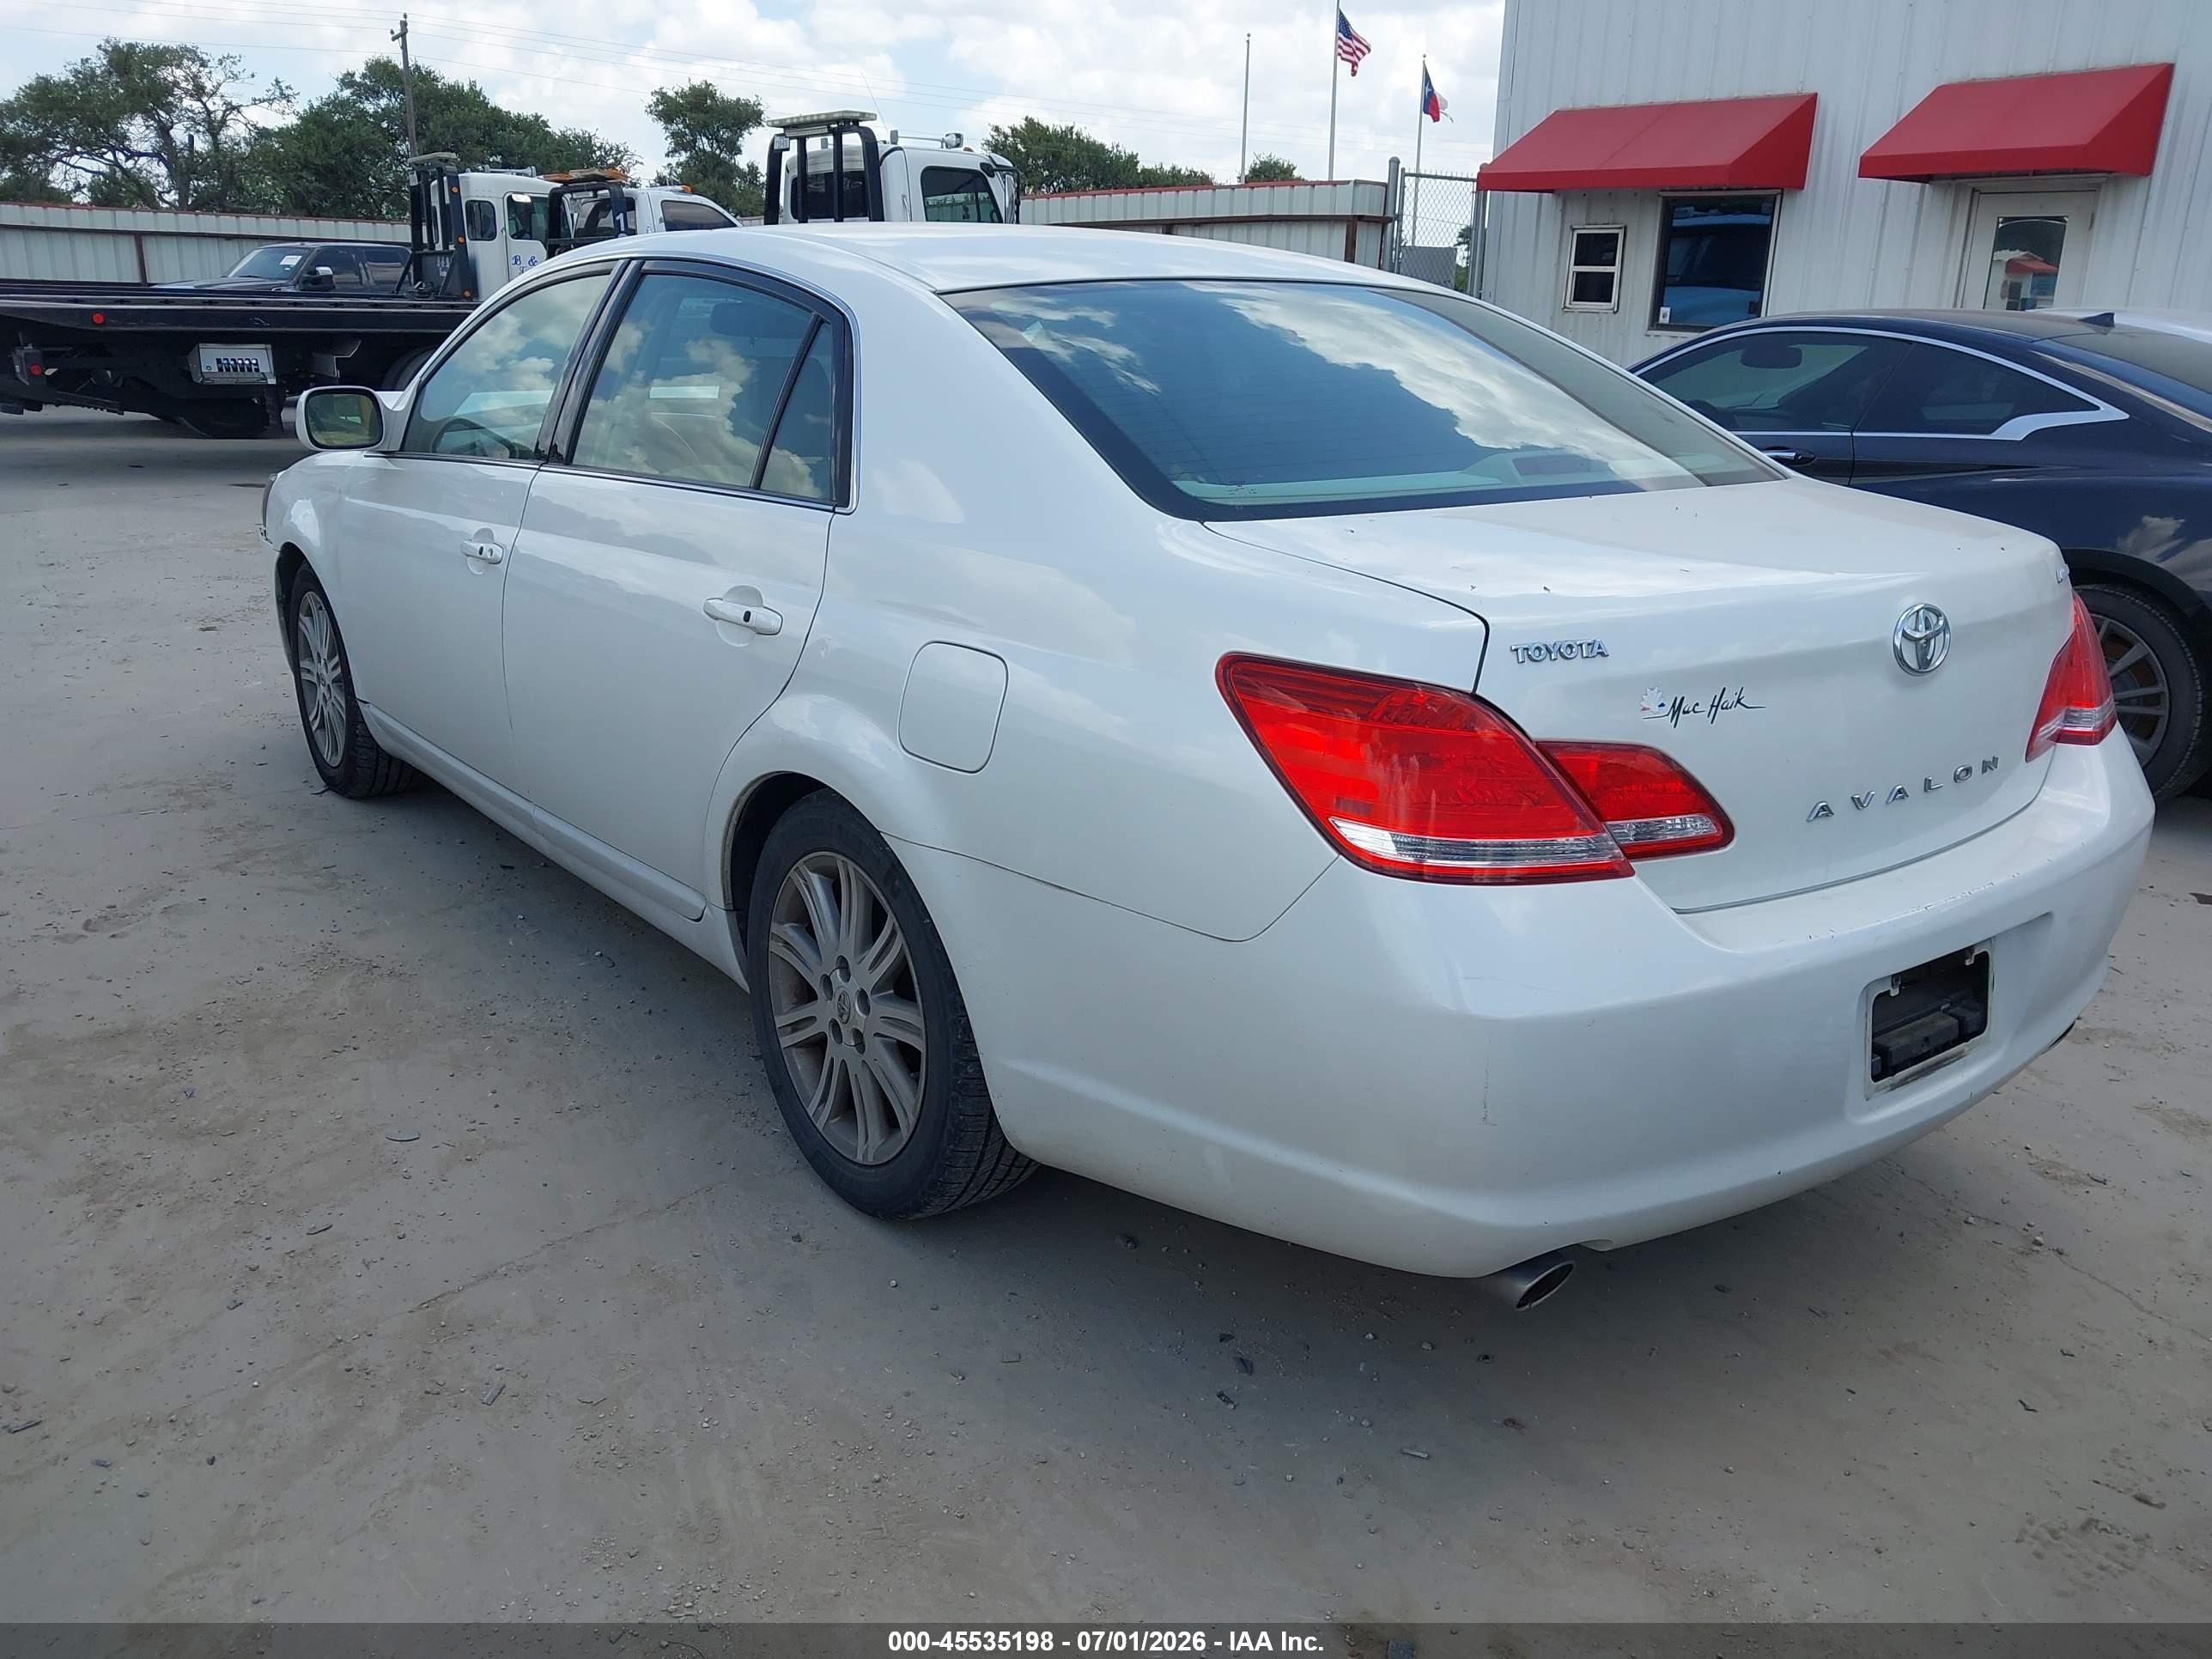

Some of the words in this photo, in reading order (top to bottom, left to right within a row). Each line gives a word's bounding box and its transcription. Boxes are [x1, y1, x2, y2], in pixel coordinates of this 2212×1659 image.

[511, 254, 522, 266] B
[527, 255, 538, 267] &
[1510, 638, 1610, 665] TOYOTA
[1642, 696, 1706, 729] Mac
[1706, 686, 1766, 725] Haik
[1805, 755, 2001, 823] AVALON
